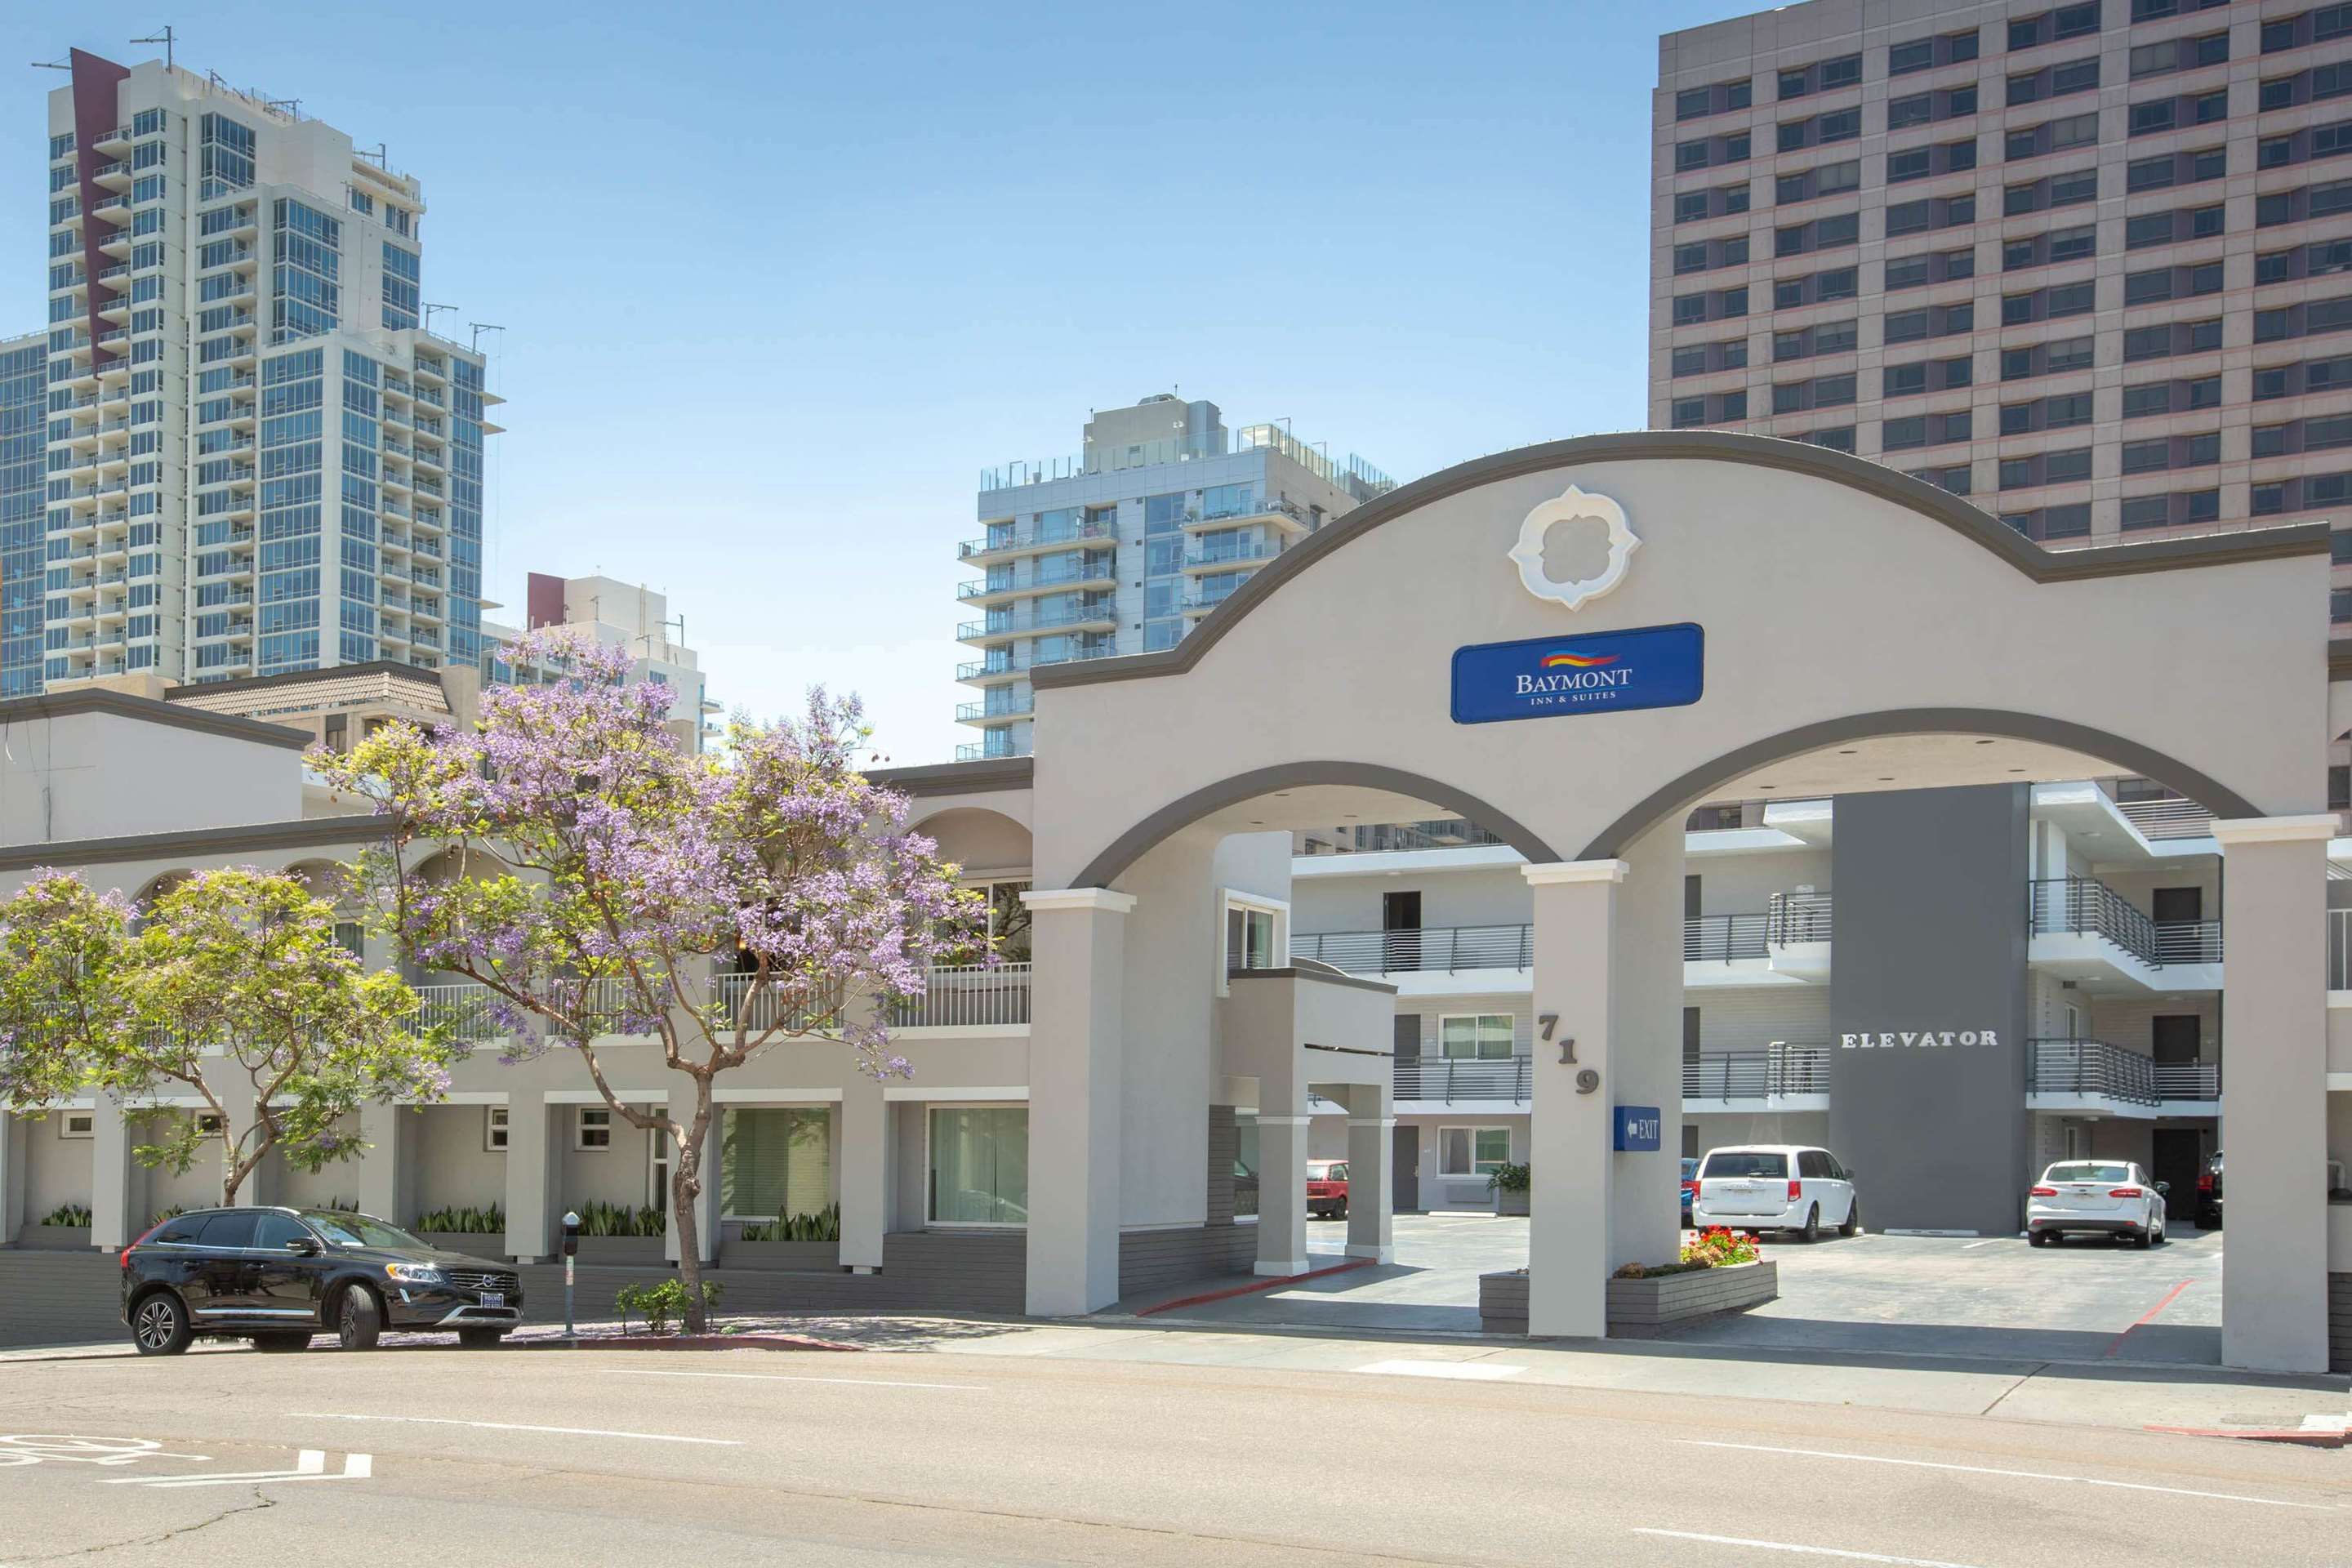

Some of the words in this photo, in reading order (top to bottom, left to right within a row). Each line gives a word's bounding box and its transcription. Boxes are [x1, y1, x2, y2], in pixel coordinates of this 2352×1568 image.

[1516, 669, 1633, 694] BAYMONT
[1530, 697, 1552, 706] INN
[1558, 695, 1567, 704] &
[1572, 691, 1616, 702] SUITES
[1841, 1030, 1998, 1049] ELEVATOR
[1639, 1119, 1659, 1139] EXIT
